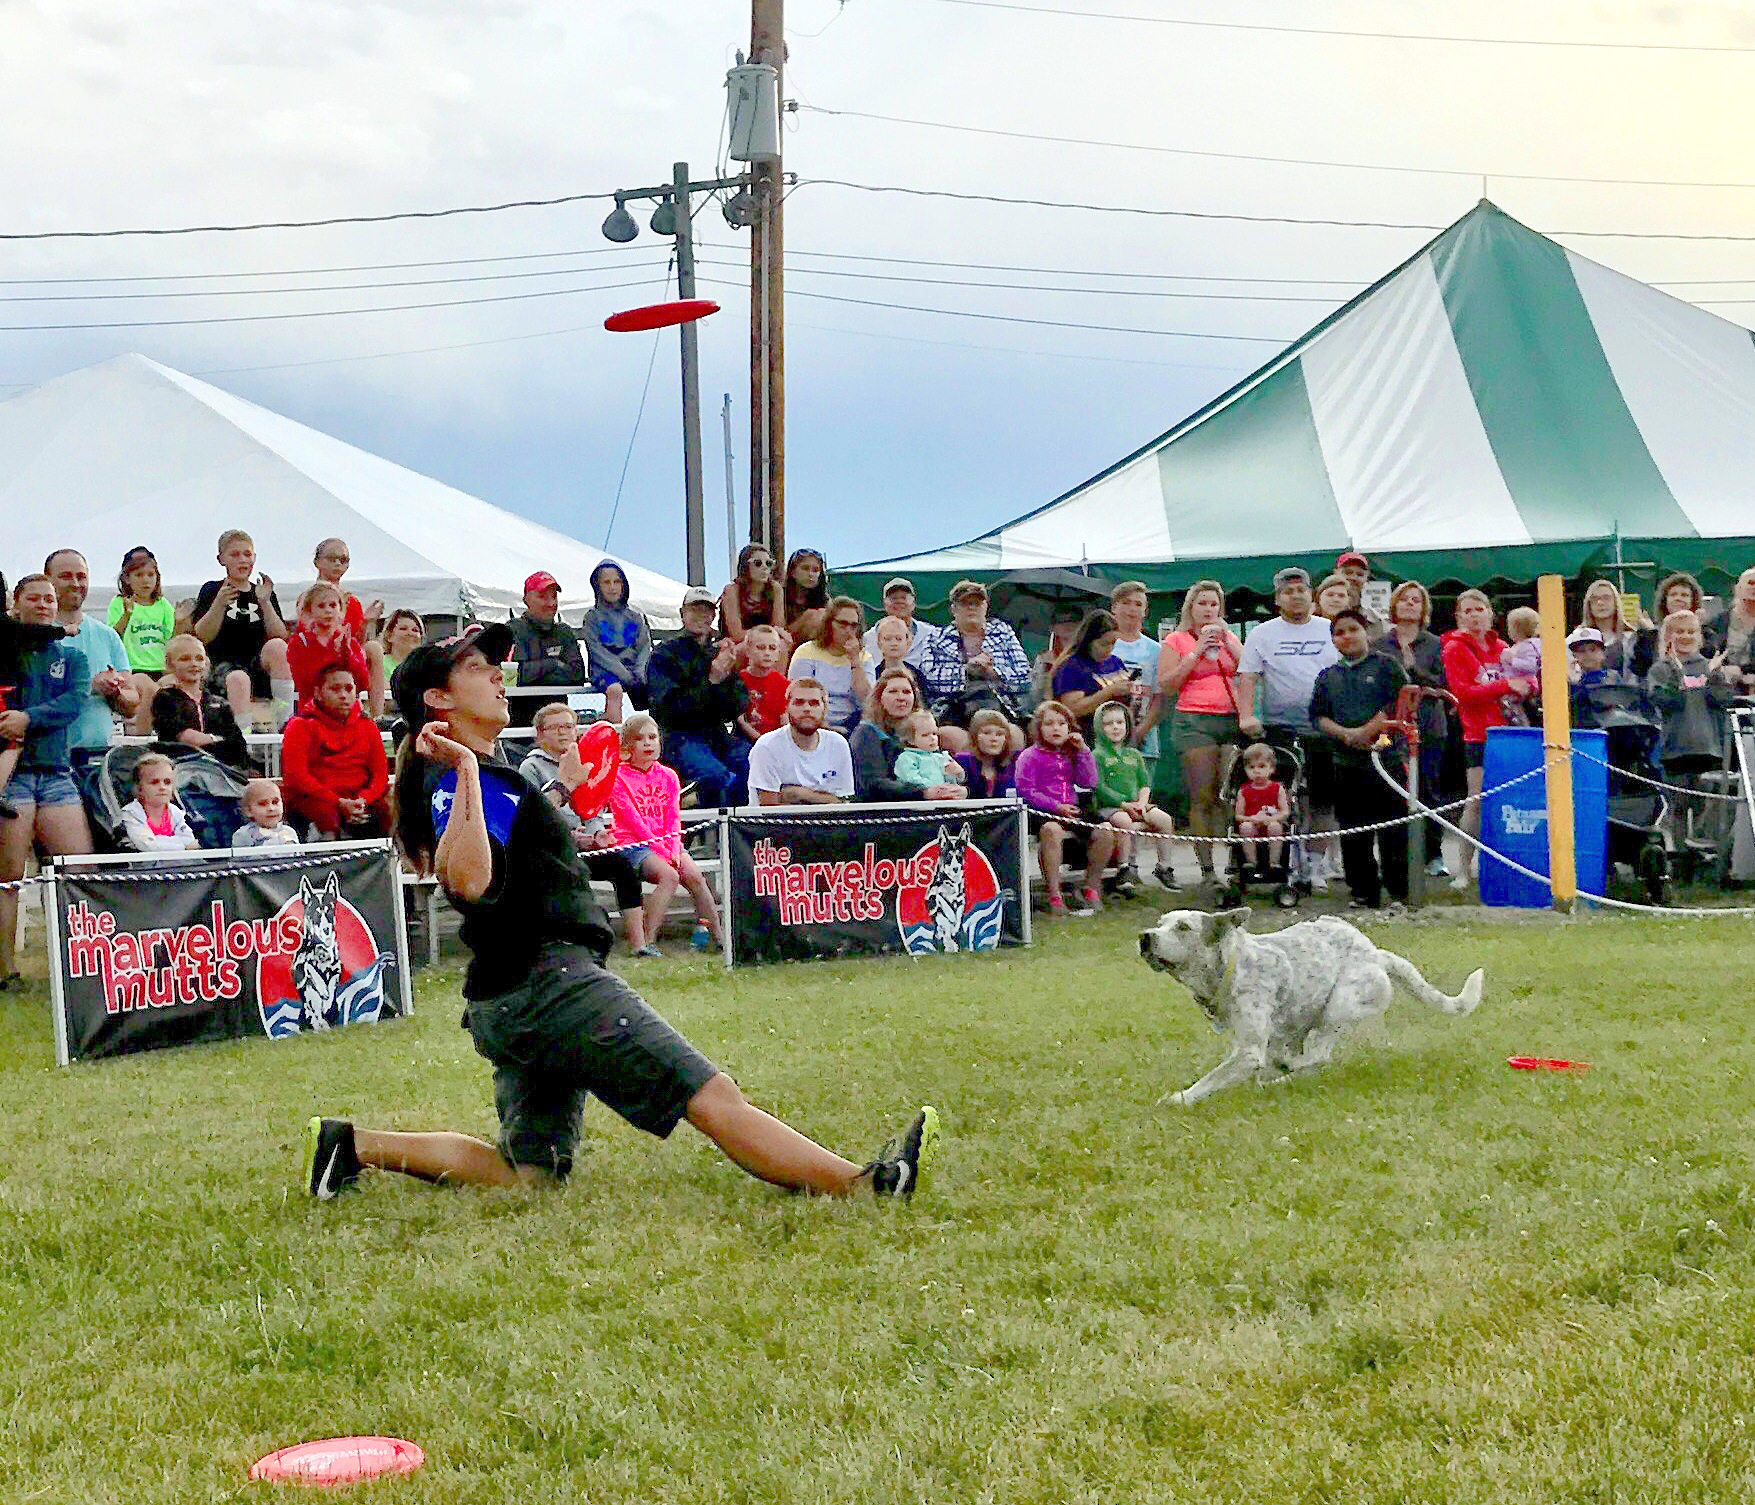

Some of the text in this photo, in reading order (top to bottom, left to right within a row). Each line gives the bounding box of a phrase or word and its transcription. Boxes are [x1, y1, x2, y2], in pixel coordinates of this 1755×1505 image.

[753, 838, 791, 867] the
[753, 842, 937, 897] marvelous
[68, 900, 116, 938] the
[779, 882, 885, 926] mutts
[68, 900, 304, 979] marvelous
[104, 952, 242, 1015] mutts
